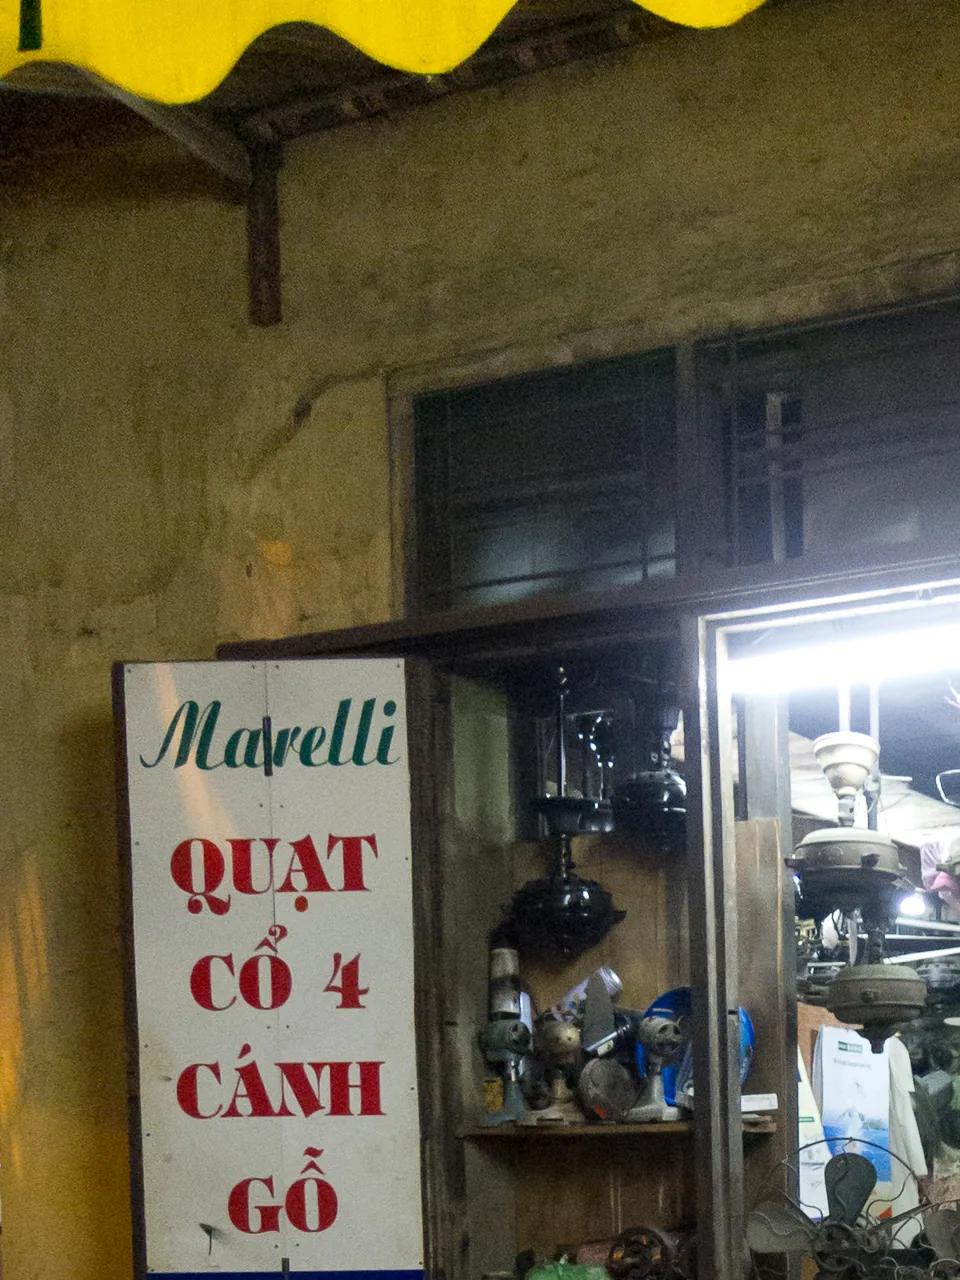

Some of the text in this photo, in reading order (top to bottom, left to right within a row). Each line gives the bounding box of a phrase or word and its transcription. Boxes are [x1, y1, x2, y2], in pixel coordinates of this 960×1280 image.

[139, 697, 401, 771] Marelli
[170, 832, 379, 916] QUẠT
[190, 924, 370, 1012] CỔ 4
[176, 1043, 387, 1119] CÁNH
[228, 1146, 339, 1234] GỖ
